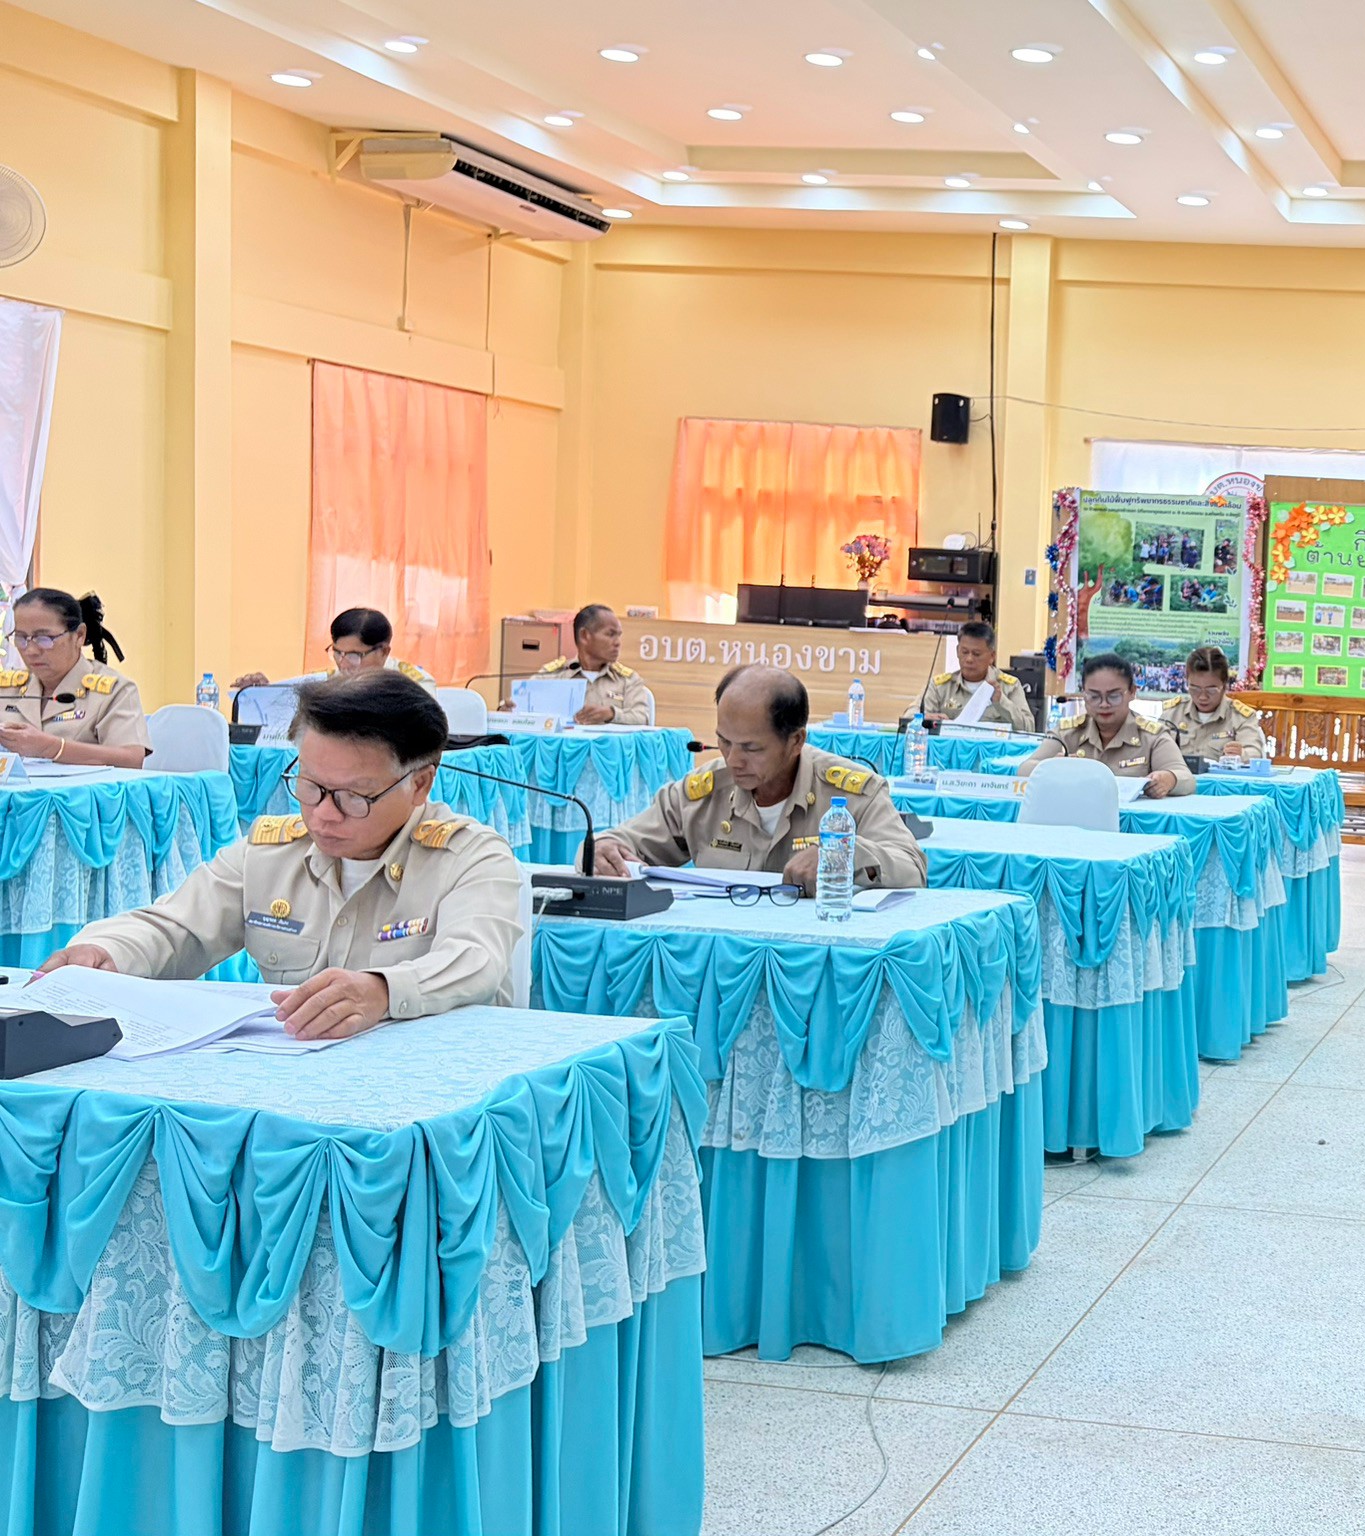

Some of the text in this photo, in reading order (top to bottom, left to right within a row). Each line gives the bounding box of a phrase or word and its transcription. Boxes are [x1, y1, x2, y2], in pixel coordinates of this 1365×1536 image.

[1209, 476, 1263, 495] บต.หนองข
[639, 634, 881, 675] อบต.หนองขาม
